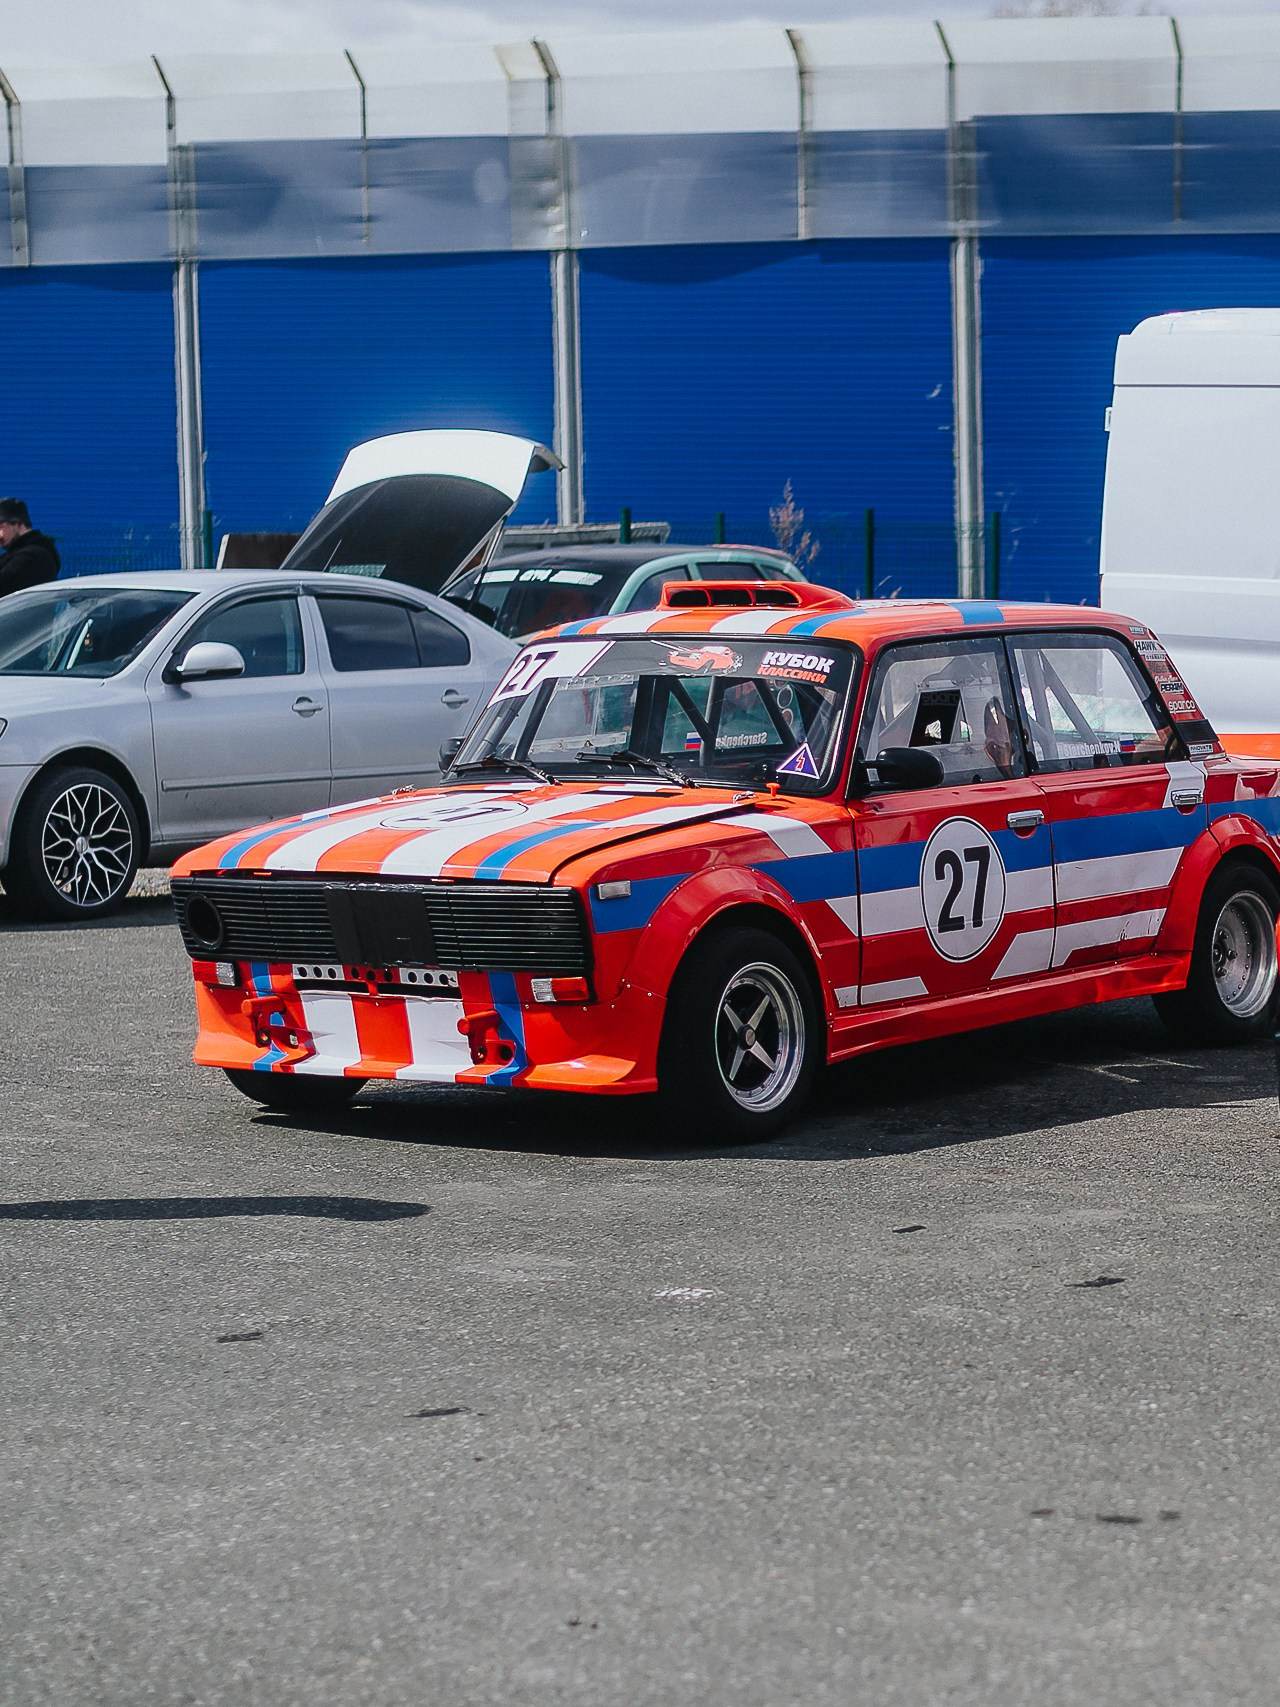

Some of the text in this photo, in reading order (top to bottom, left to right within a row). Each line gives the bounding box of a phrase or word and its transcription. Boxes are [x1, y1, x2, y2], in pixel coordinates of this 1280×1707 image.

[1134, 641, 1157, 651] HAWK
[761, 651, 835, 673] КУБОК
[498, 650, 560, 696] 27
[757, 667, 828, 684] КЛАССИКИ
[921, 692, 960, 707] sparc
[1168, 700, 1196, 714] sparco
[934, 845, 991, 934] 27
